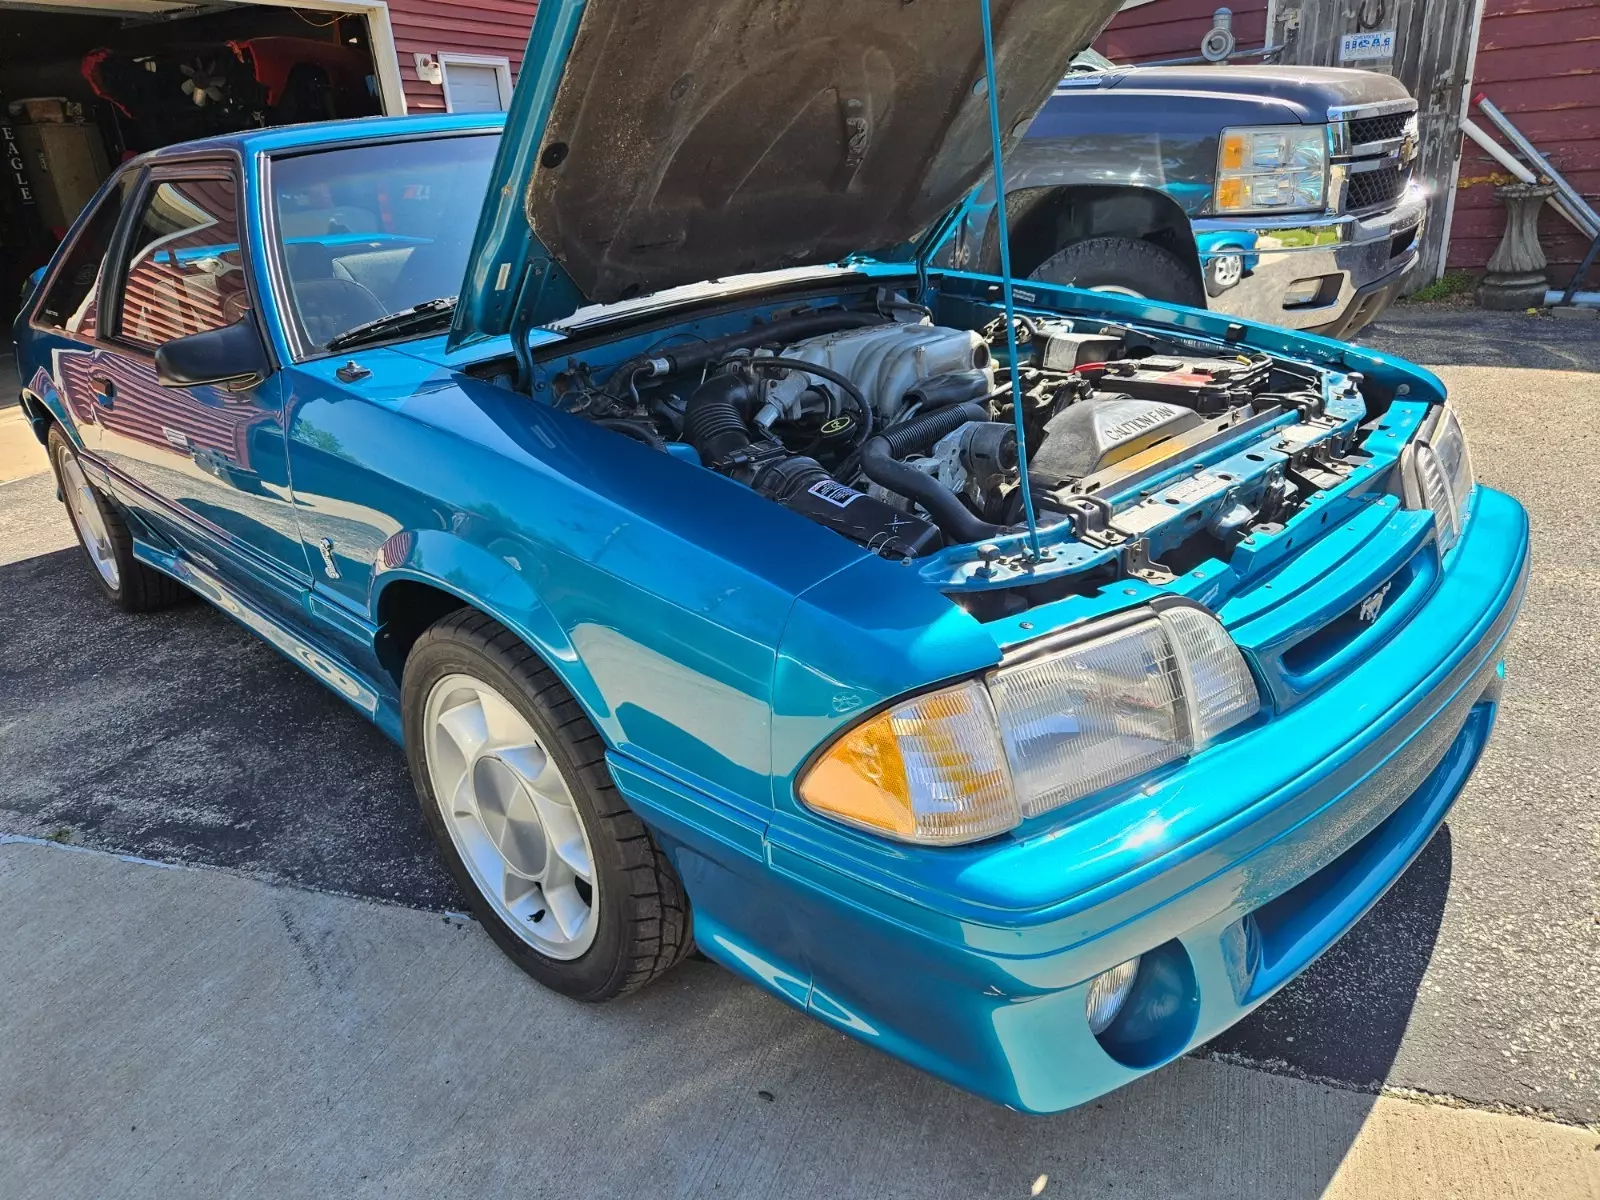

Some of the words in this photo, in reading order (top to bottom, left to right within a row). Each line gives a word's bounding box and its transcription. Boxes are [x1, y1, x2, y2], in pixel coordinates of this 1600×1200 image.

[2, 127, 33, 200] EAGLE
[1104, 414, 1153, 441] CAUTION
[1149, 405, 1177, 422] FAN
